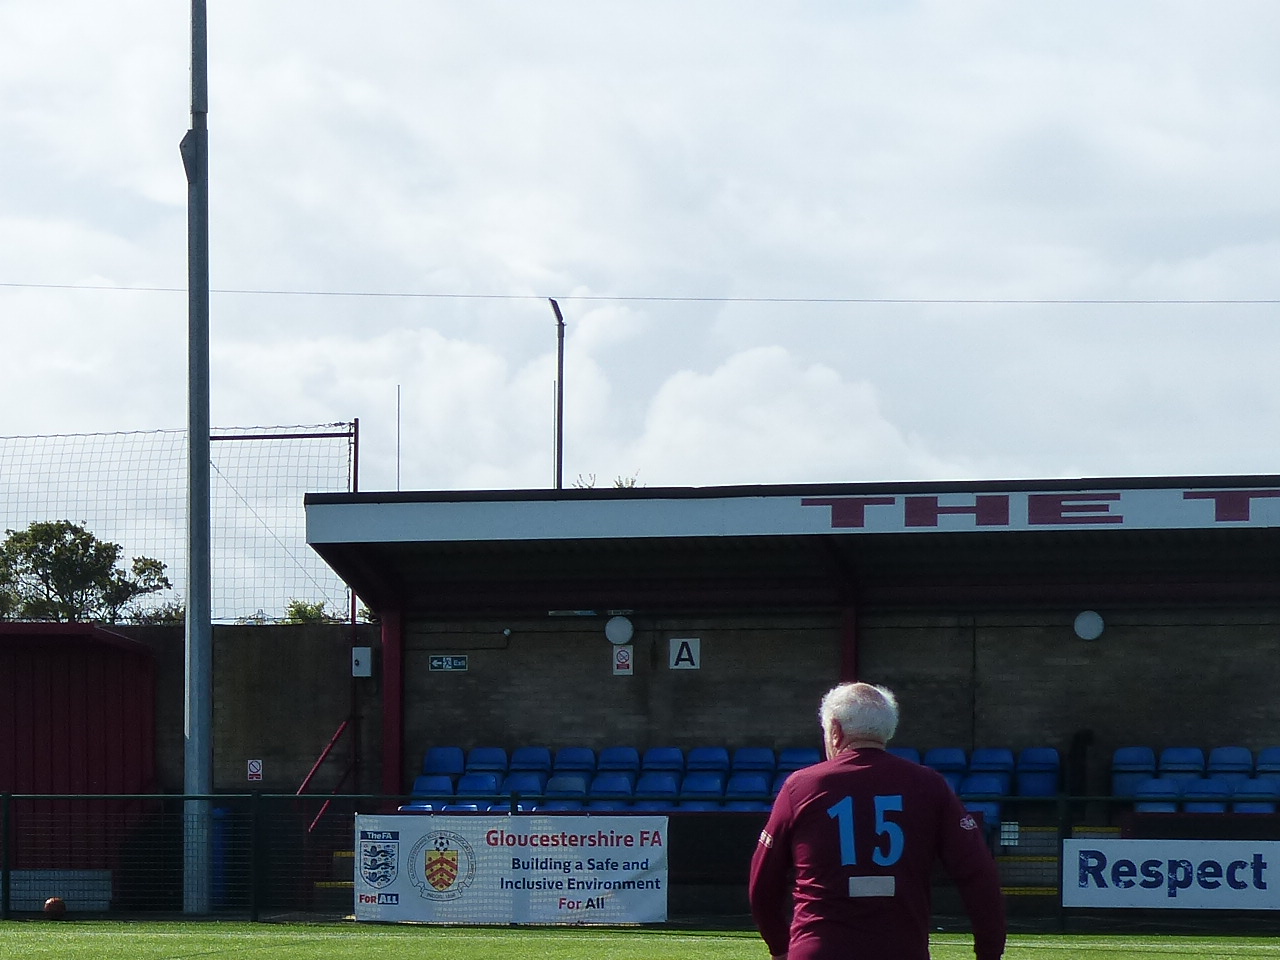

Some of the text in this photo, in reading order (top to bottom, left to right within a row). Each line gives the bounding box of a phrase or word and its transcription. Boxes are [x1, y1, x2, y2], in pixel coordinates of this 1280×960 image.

[801, 492, 1124, 528] THE
[674, 641, 695, 666] A
[486, 829, 663, 847] Gloucestershire FA
[827, 795, 905, 867] 15
[512, 857, 649, 873] Building a Safe and
[1078, 849, 1268, 897] Respect
[500, 877, 661, 891] Inclusive Environment
[558, 897, 605, 910] For All
